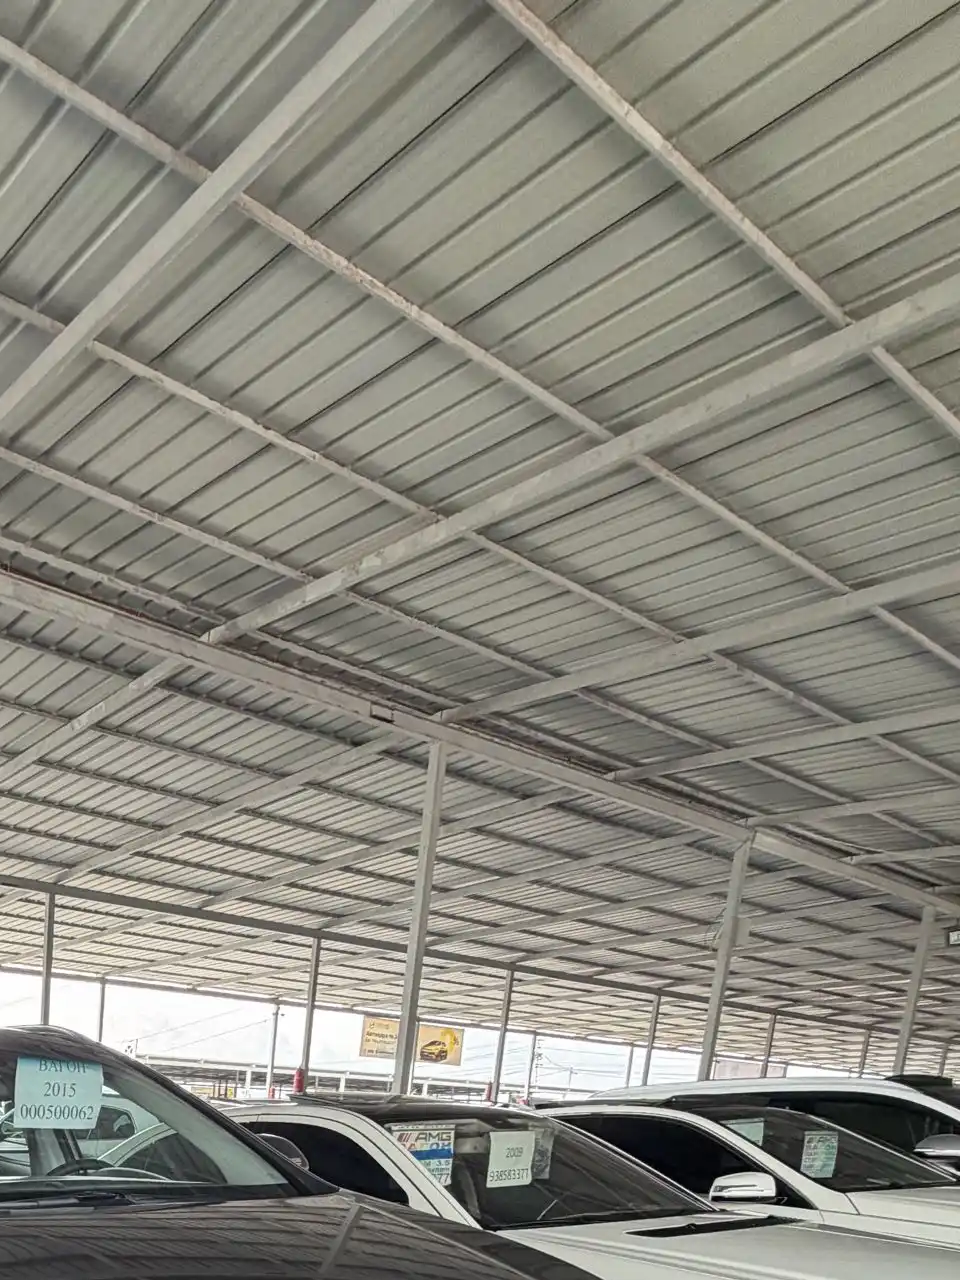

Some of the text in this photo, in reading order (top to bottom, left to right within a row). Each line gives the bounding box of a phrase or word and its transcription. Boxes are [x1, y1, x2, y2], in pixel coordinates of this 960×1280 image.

[43, 1082, 77, 1097] 2015
[20, 1104, 94, 1120] 000500062
[414, 1131, 452, 1142] AMG
